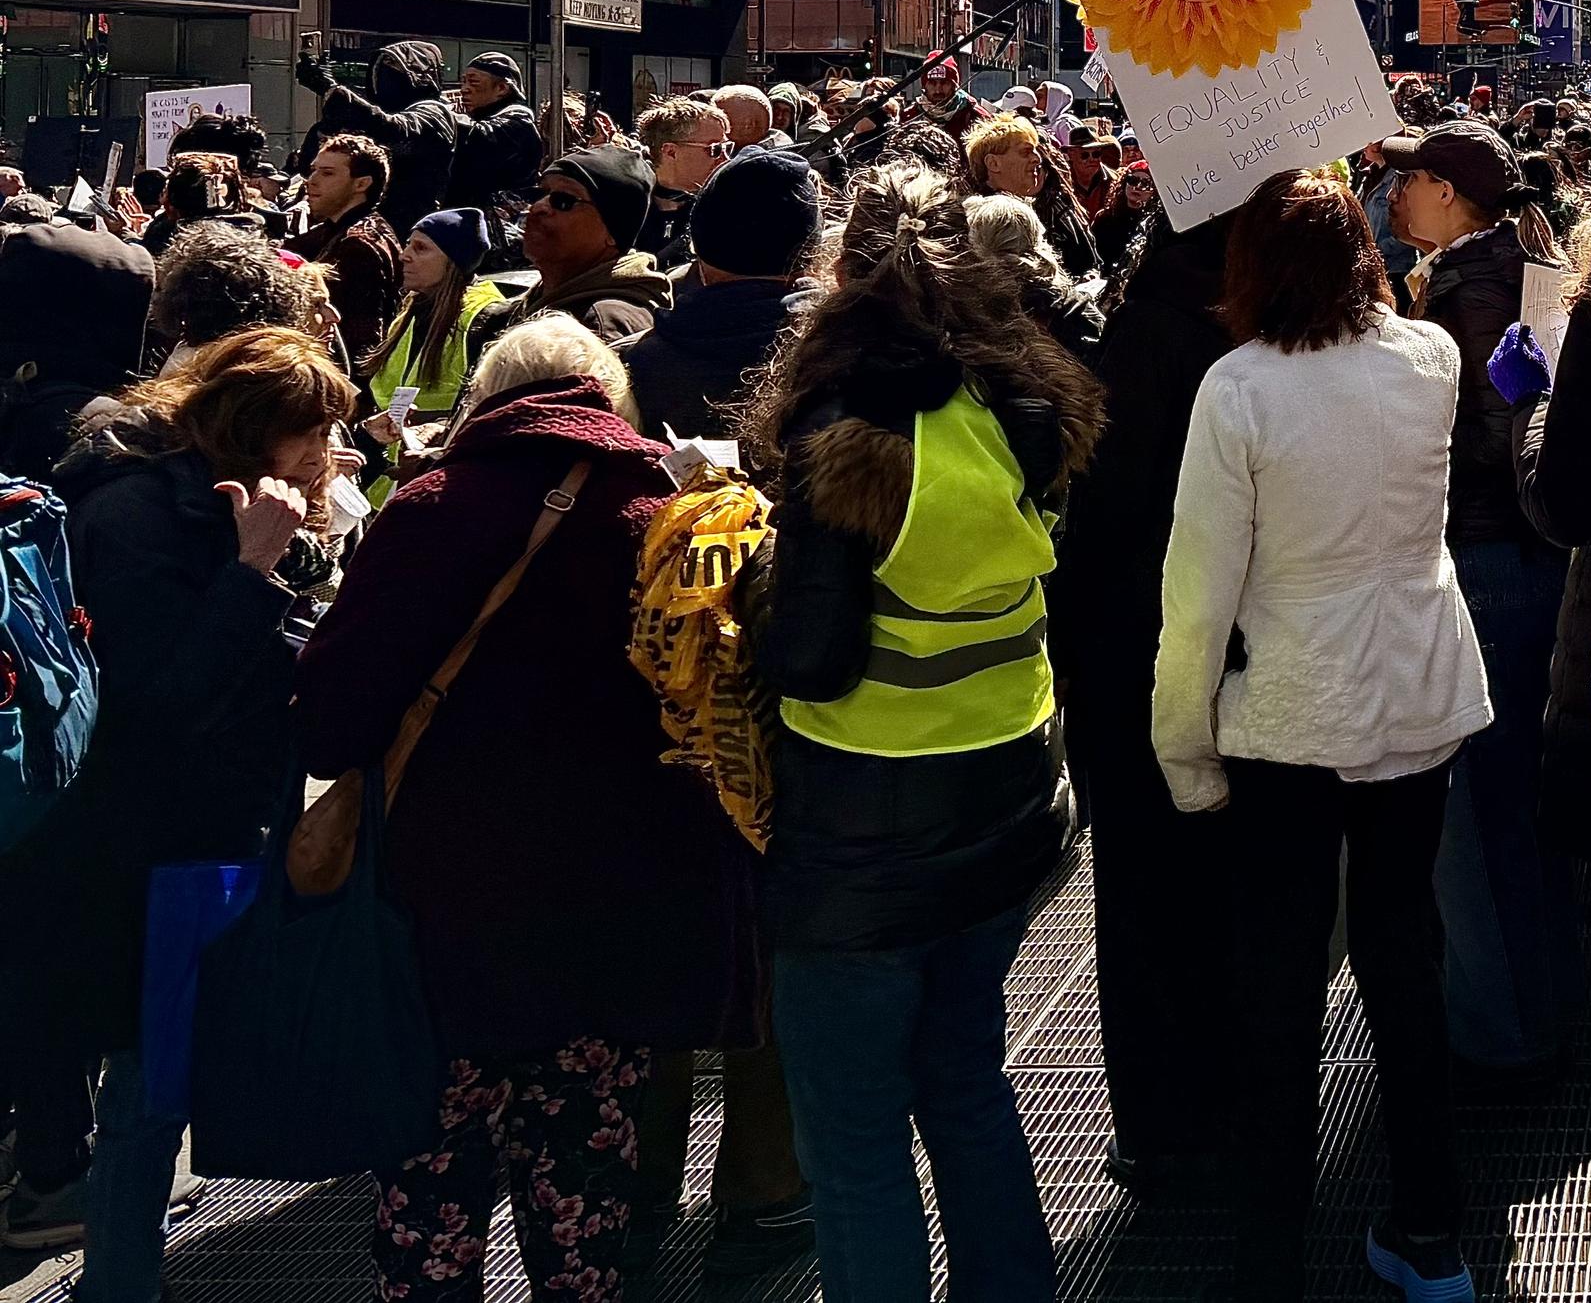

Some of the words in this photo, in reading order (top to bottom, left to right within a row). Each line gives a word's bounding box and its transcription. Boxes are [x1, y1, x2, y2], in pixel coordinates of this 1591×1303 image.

[569, 0, 583, 16] KEEP
[583, 2, 607, 20] MOVING
[1148, 48, 1301, 144] EQUALITY
[1218, 77, 1313, 138] JUSTICE
[1167, 163, 1222, 206] We're
[1229, 133, 1280, 171] better
